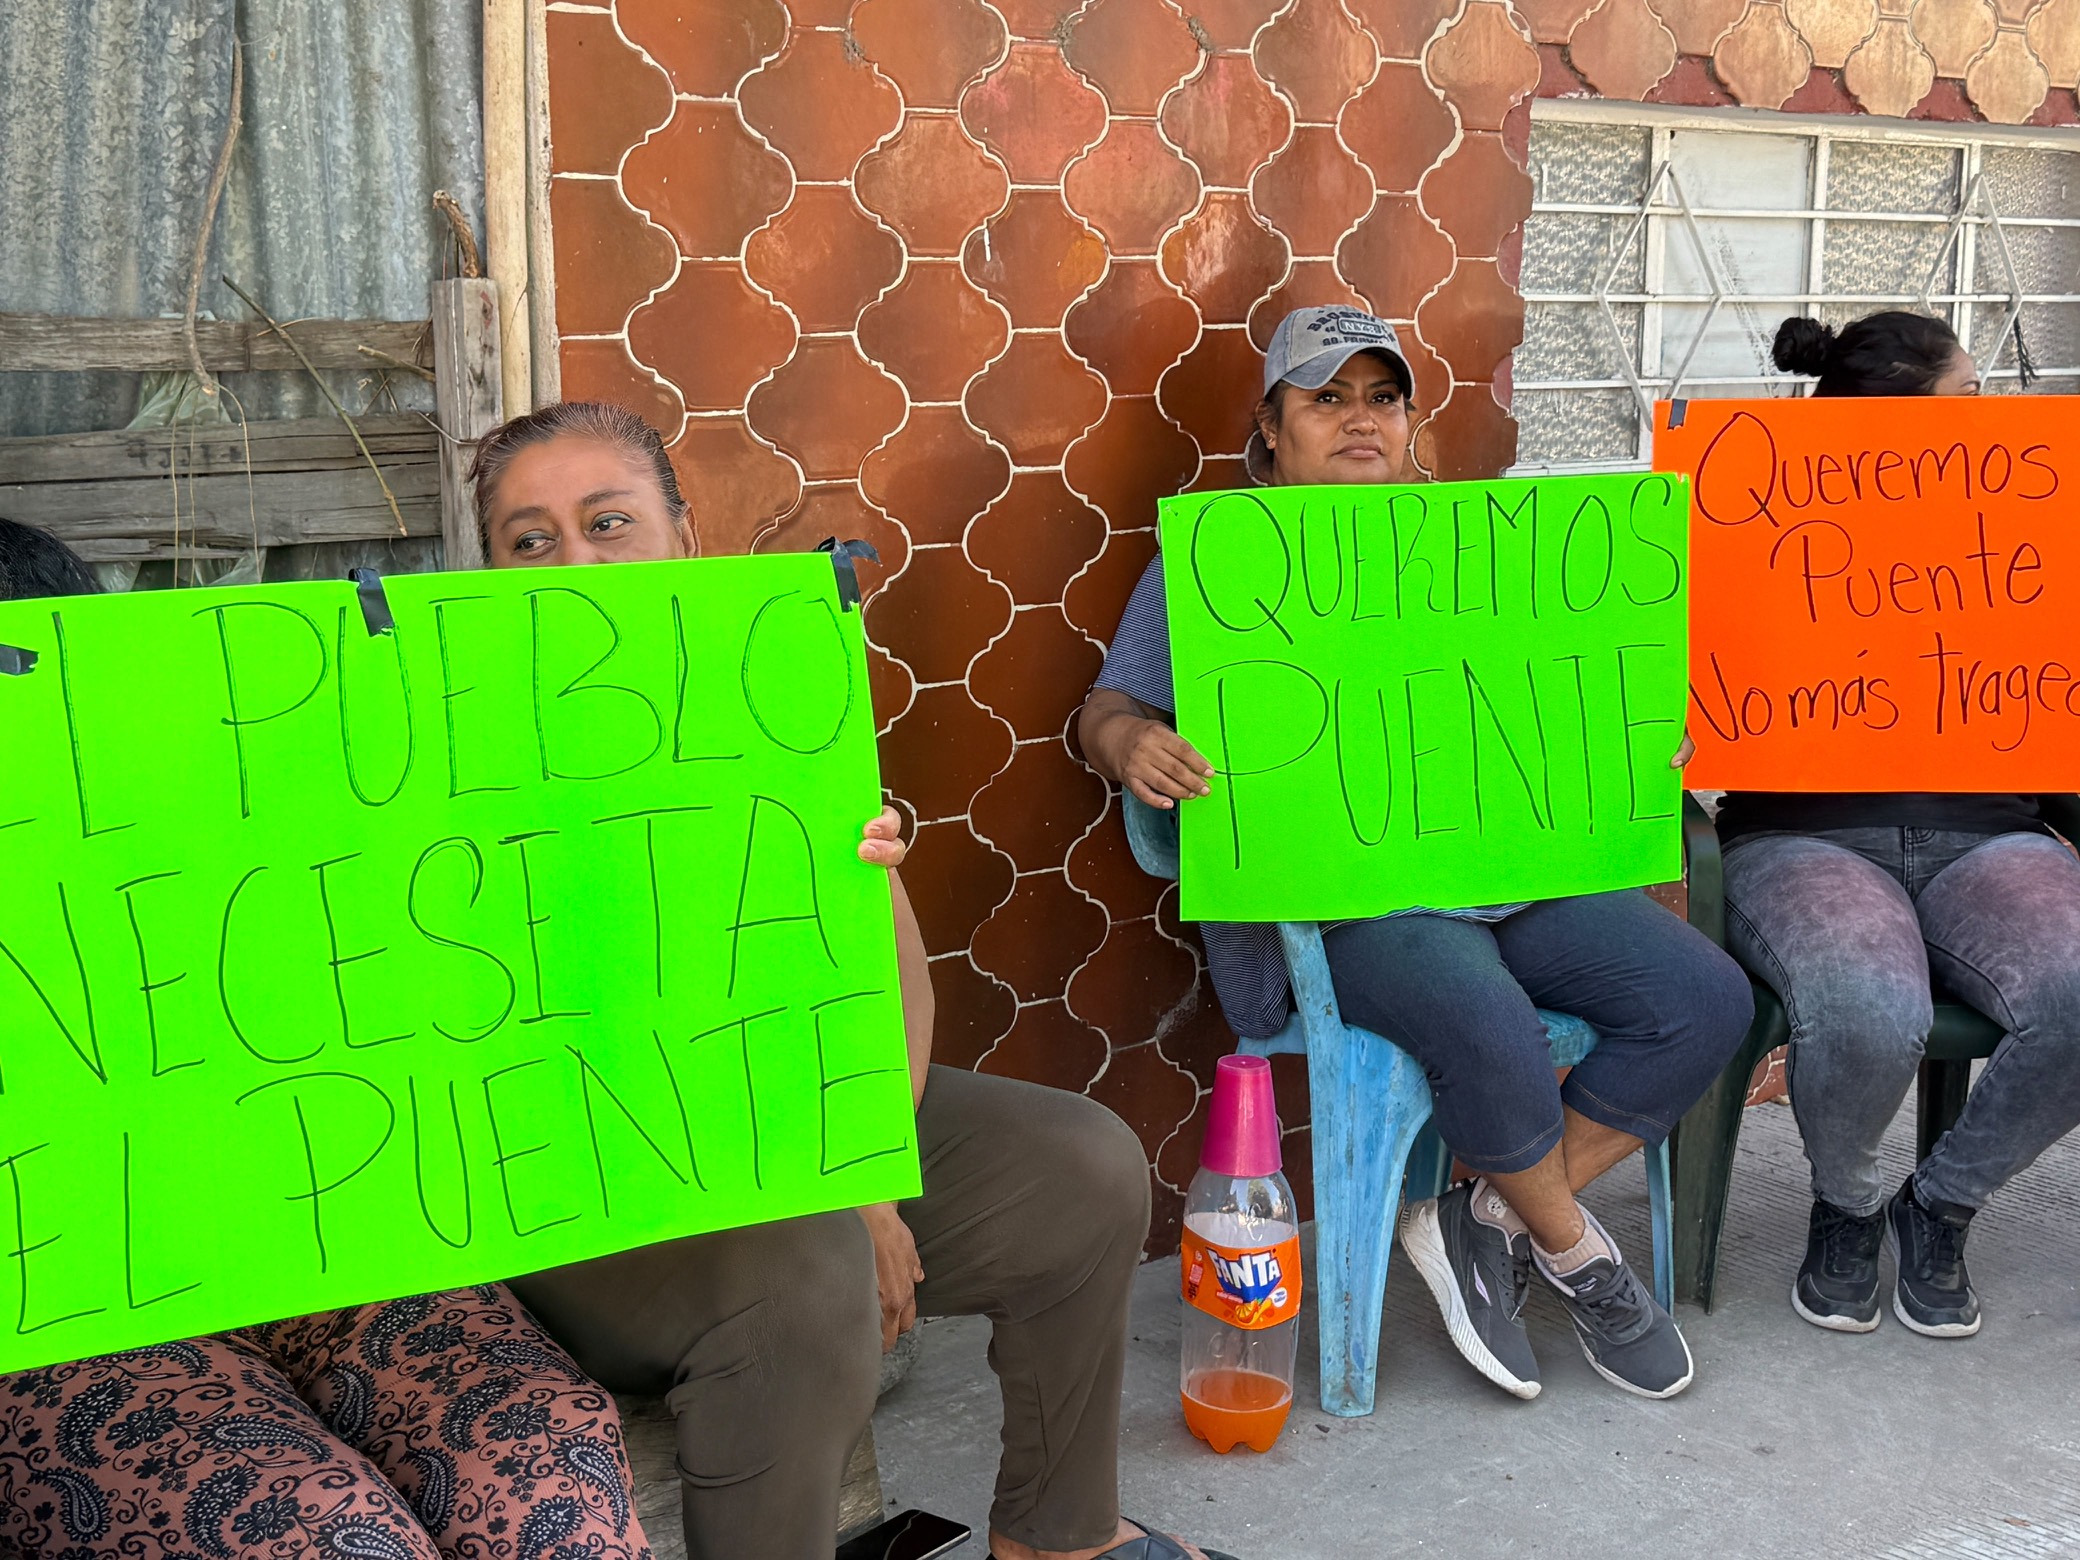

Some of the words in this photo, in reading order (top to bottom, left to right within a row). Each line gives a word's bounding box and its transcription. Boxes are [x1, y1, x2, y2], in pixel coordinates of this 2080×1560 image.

[1694, 411, 2059, 528] Queremos
[1190, 477, 1681, 646] QUEREMOS
[1769, 511, 2044, 624] Puente
[192, 588, 854, 820] PUEBLO
[1196, 643, 1678, 870] PUENTE
[1787, 649, 1900, 731] más
[0, 1143, 202, 1335] EL
[234, 989, 908, 1274] PUENTE
